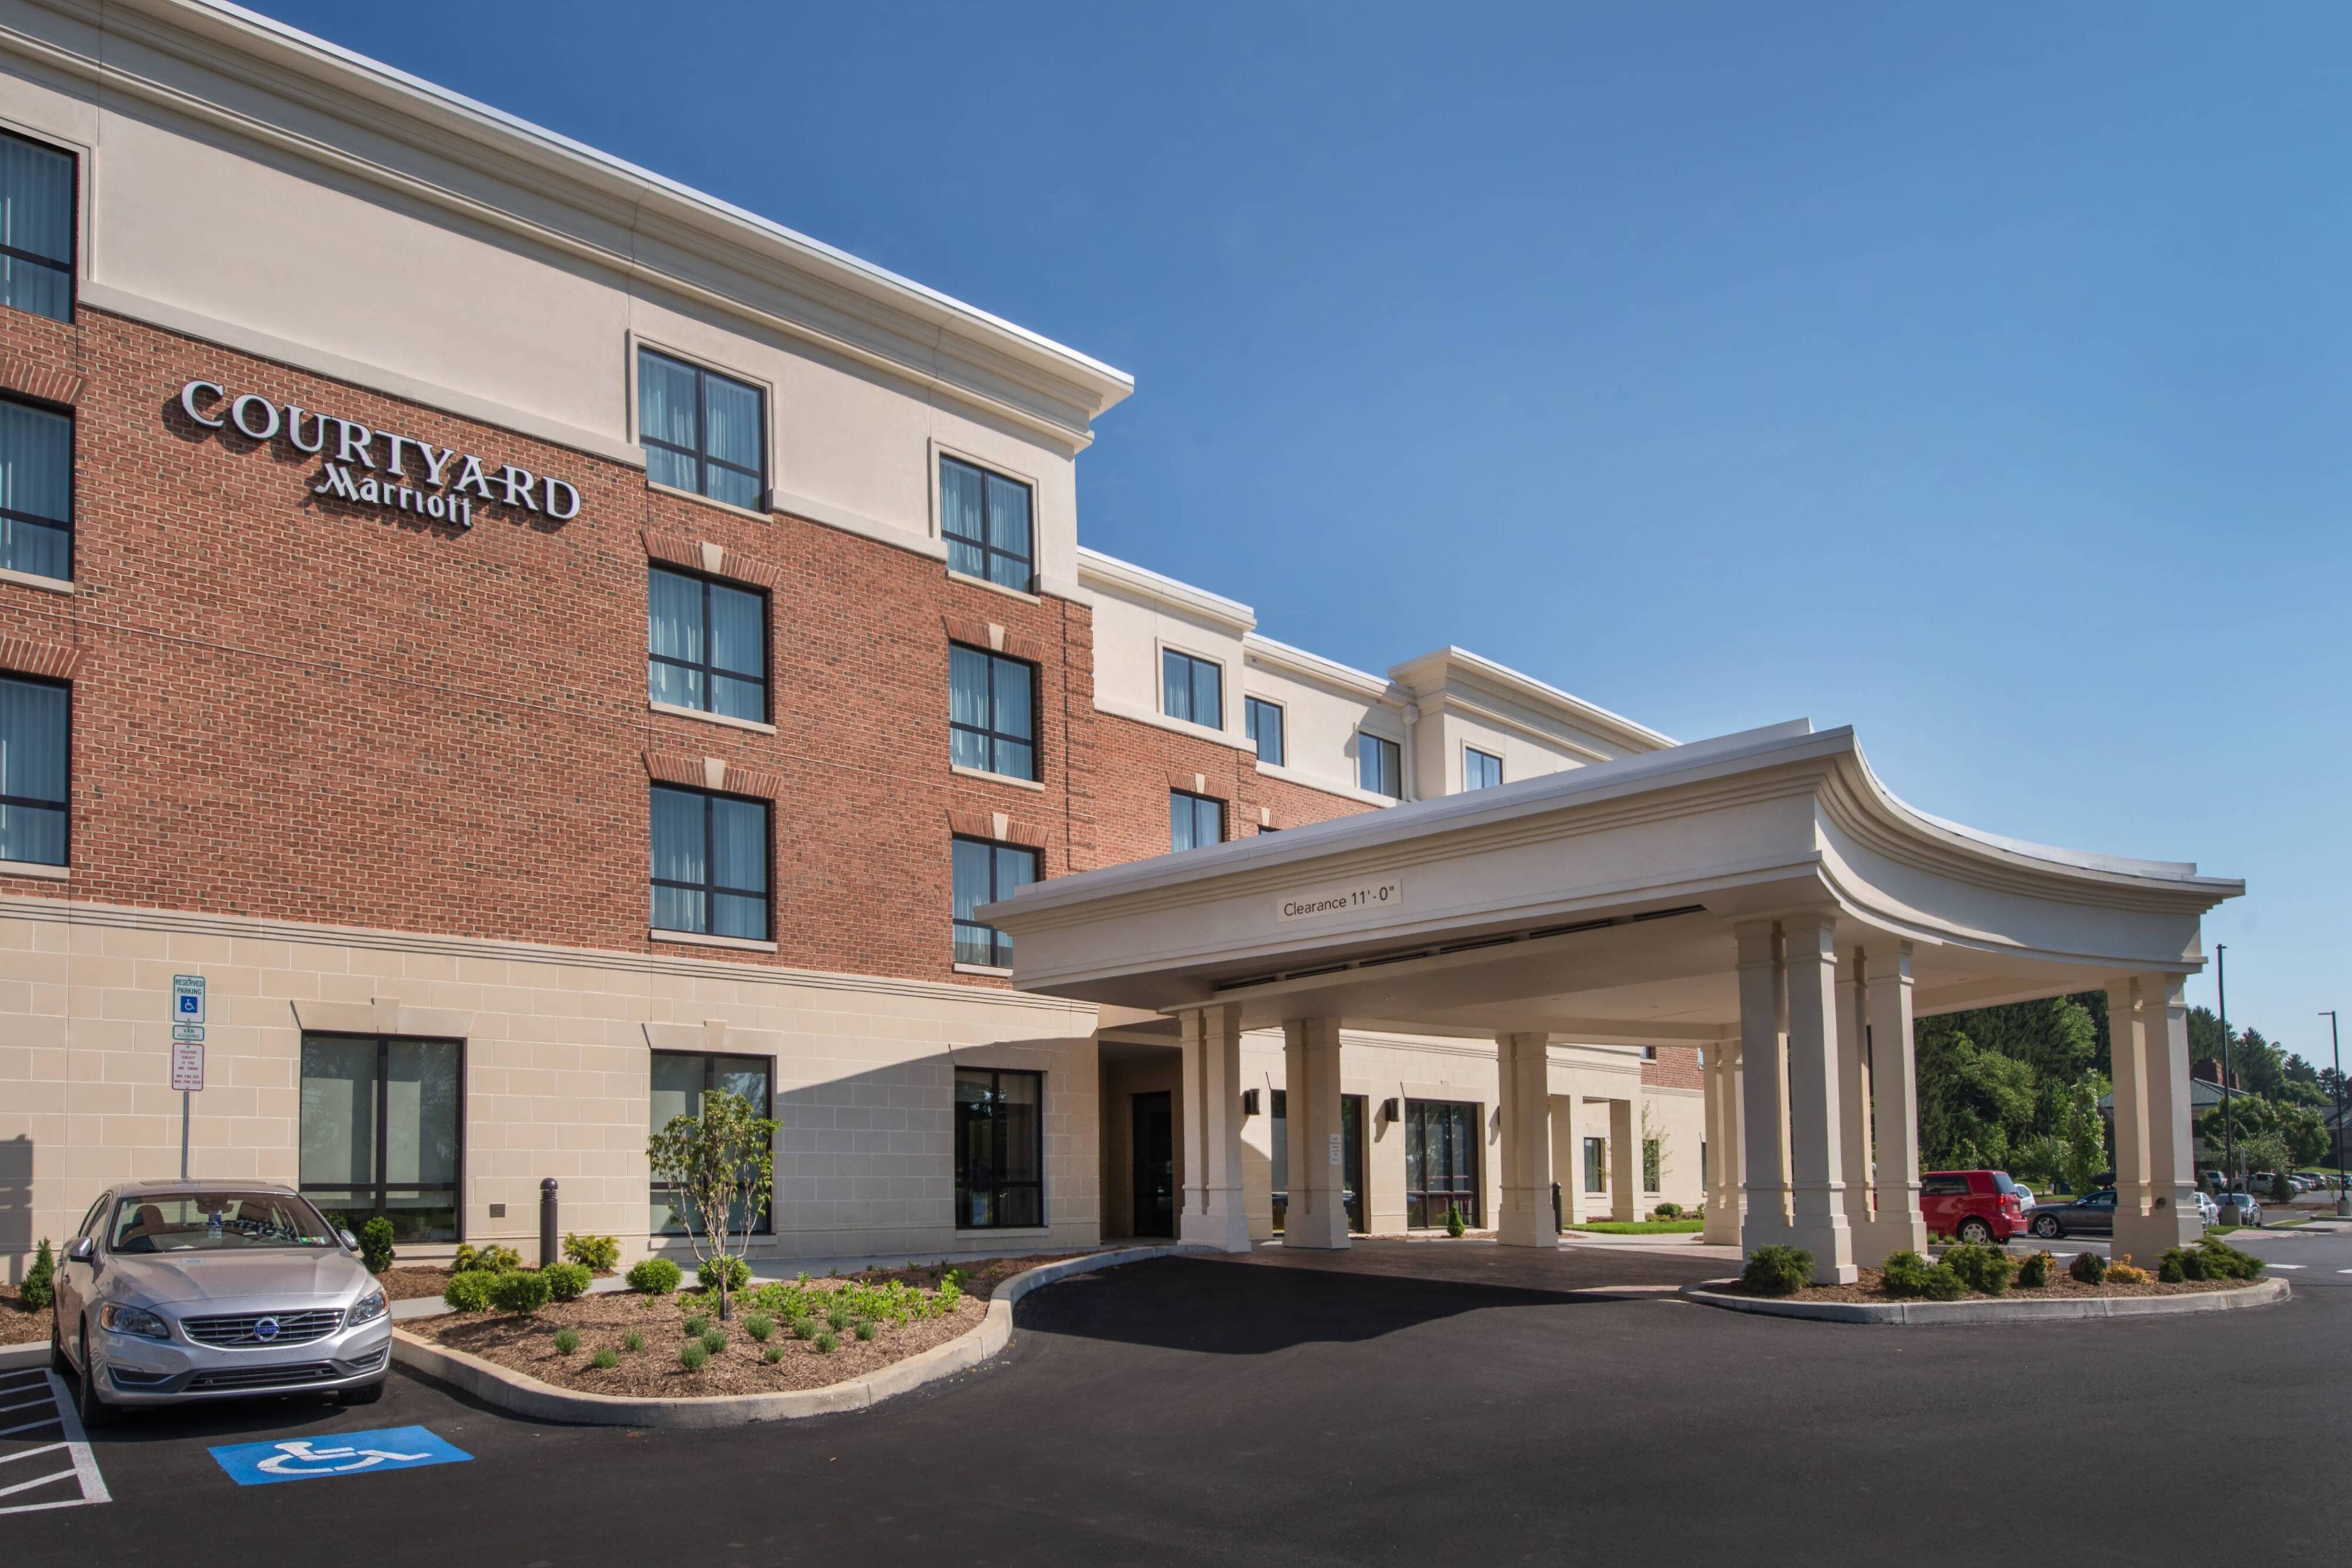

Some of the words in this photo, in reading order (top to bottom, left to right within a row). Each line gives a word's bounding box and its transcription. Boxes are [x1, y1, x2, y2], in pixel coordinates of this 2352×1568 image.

[181, 379, 582, 521] COURTYARD
[313, 462, 473, 527] Marriott
[1284, 897, 1347, 917] Clearance
[176, 978, 203, 987] RESERVED
[177, 987, 202, 995] PARKING
